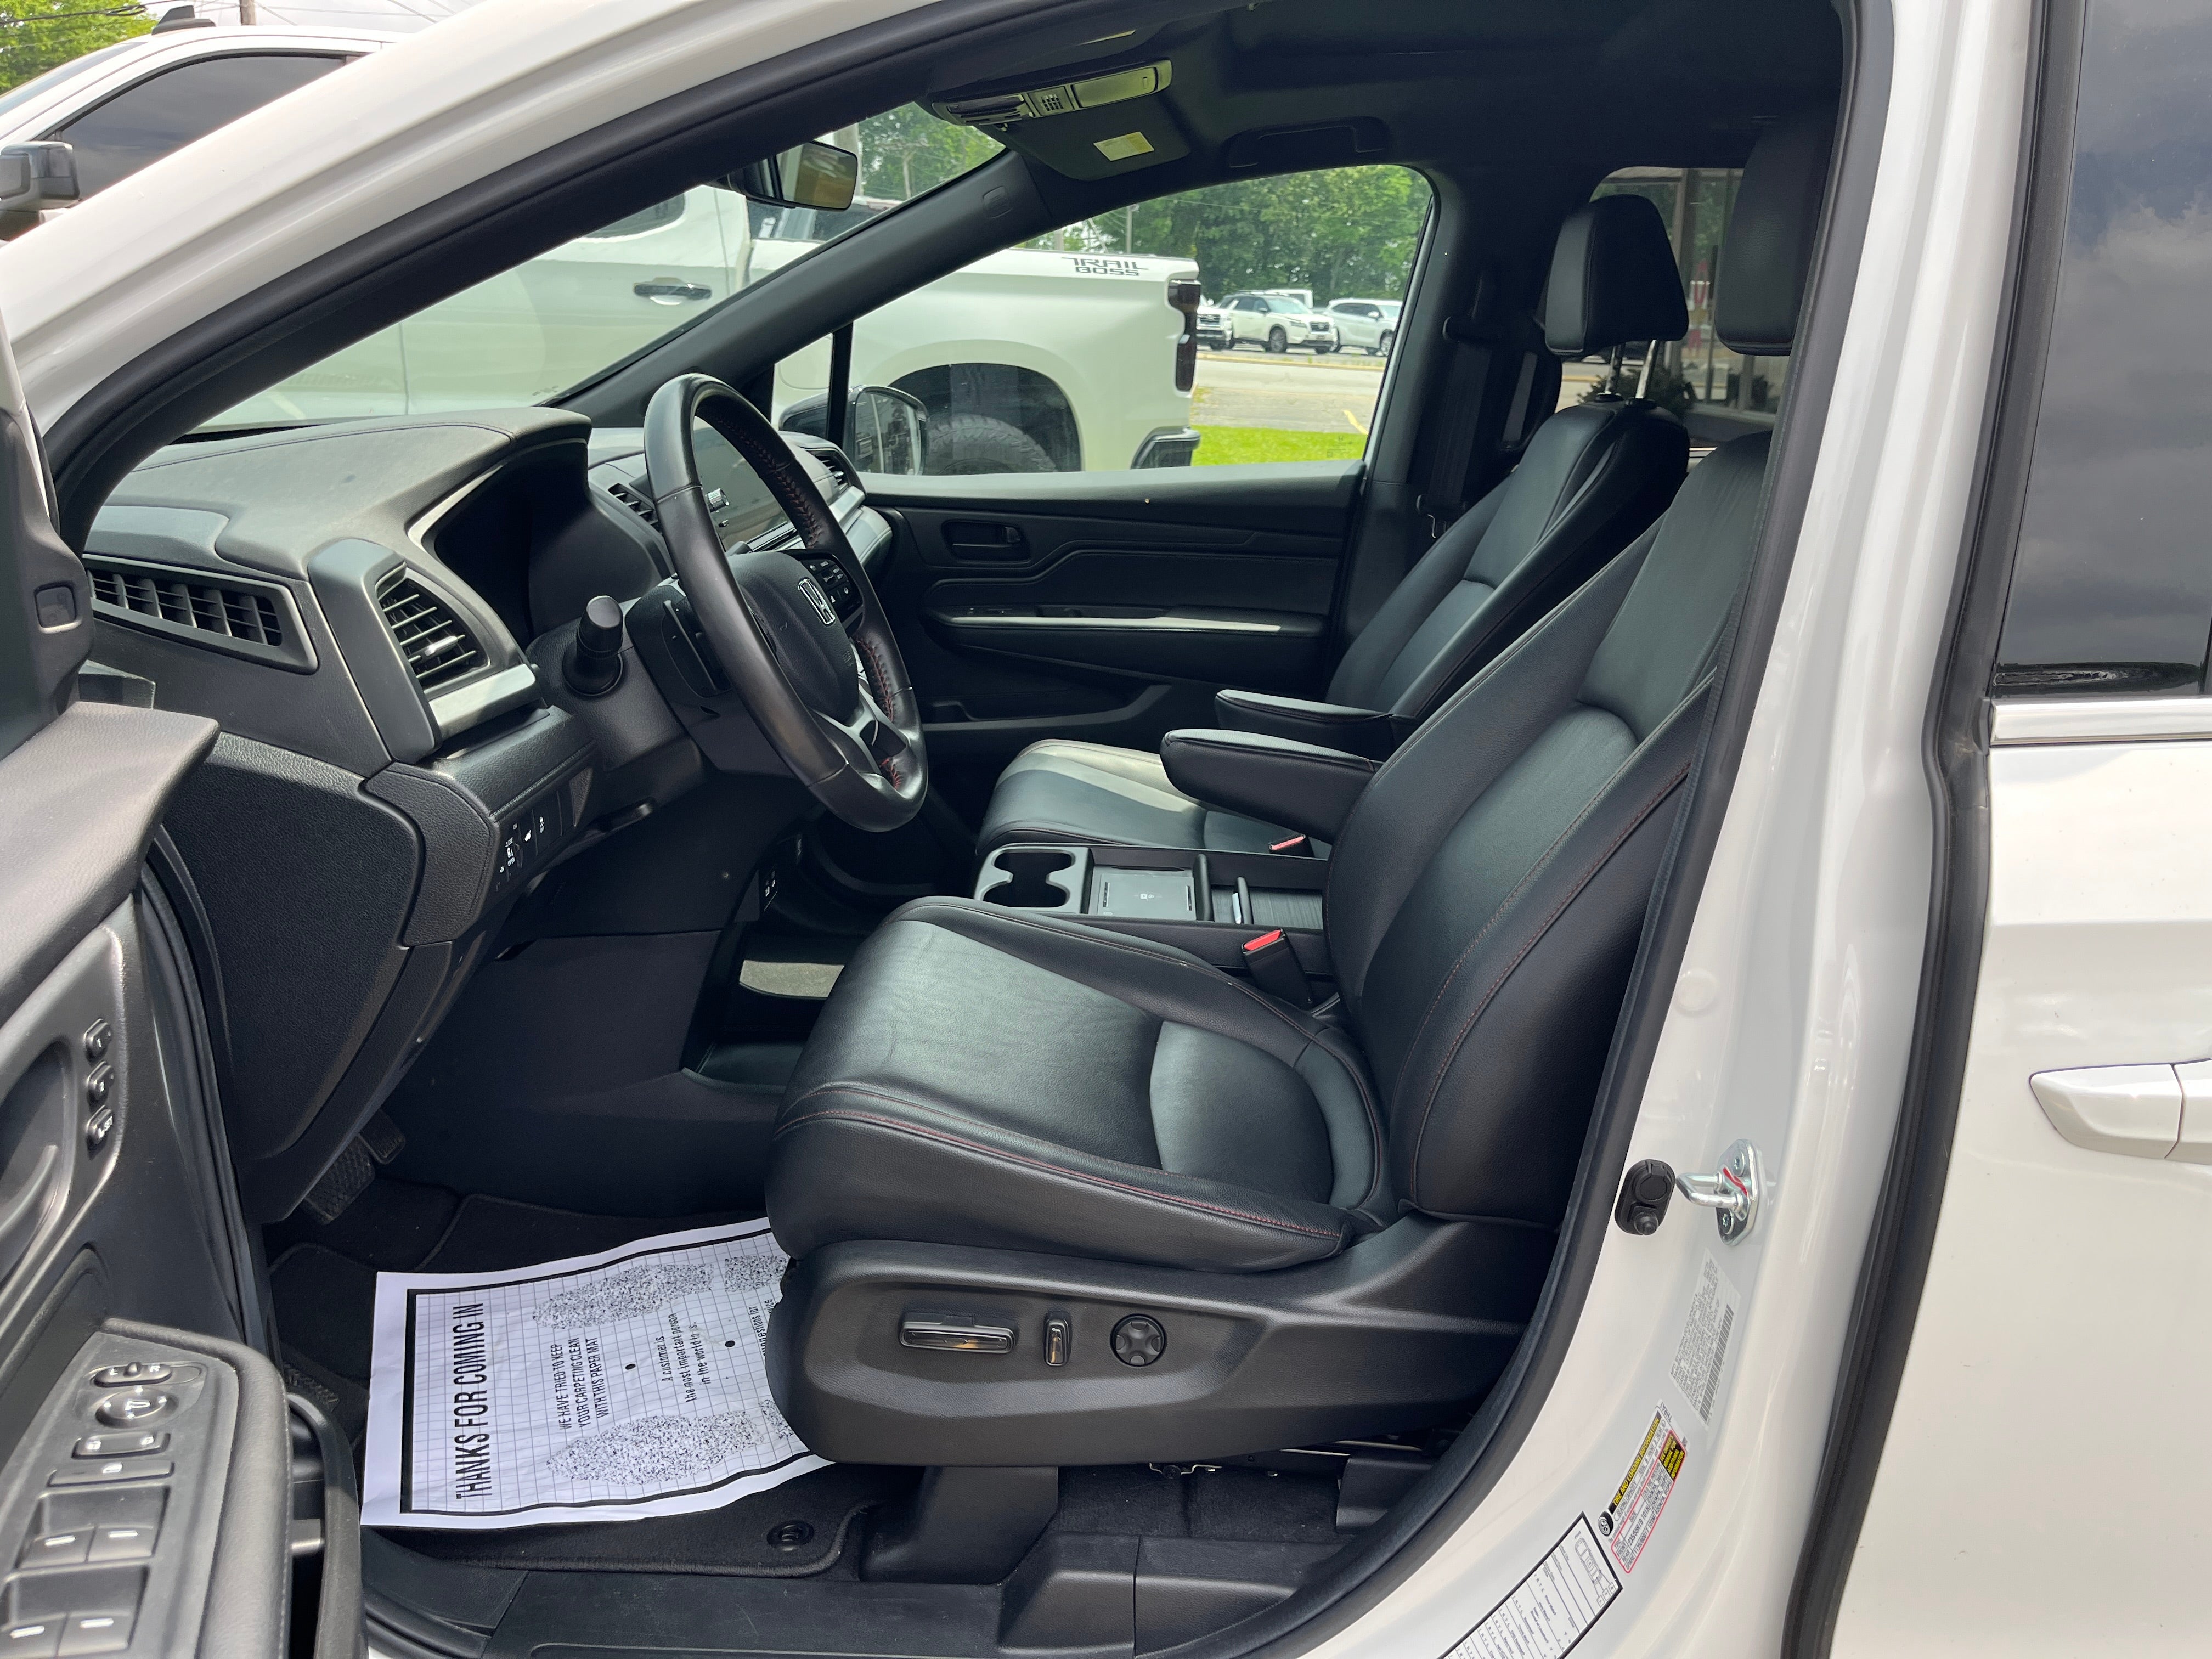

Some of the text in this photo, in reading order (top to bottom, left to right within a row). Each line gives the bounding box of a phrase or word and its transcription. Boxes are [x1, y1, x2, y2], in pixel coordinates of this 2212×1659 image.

[1061, 257, 1149, 270] TRAIL
[1075, 266, 1139, 276] BOSS
[97, 1039, 101, 1048] 1
[748, 1306, 759, 1314] for
[657, 1344, 672, 1374] customer
[668, 1313, 697, 1402] the most important person
[690, 1340, 706, 1360] world
[149, 1364, 160, 1373] R
[585, 1337, 609, 1418] WITH THIS PAPER MAT
[697, 1362, 709, 1374] the
[550, 1344, 572, 1430] WE HAVE TRIED TO KEEP
[568, 1337, 591, 1427] YOUR CARPETING CLEAN
[452, 1303, 492, 1499] THANKS FOR COMING IN
[1612, 1418, 1659, 1505] TIRE AND LOADING INFORMATION
[1616, 1499, 1627, 1516] SEATING
[1627, 1518, 1643, 1545] 235/55R19
